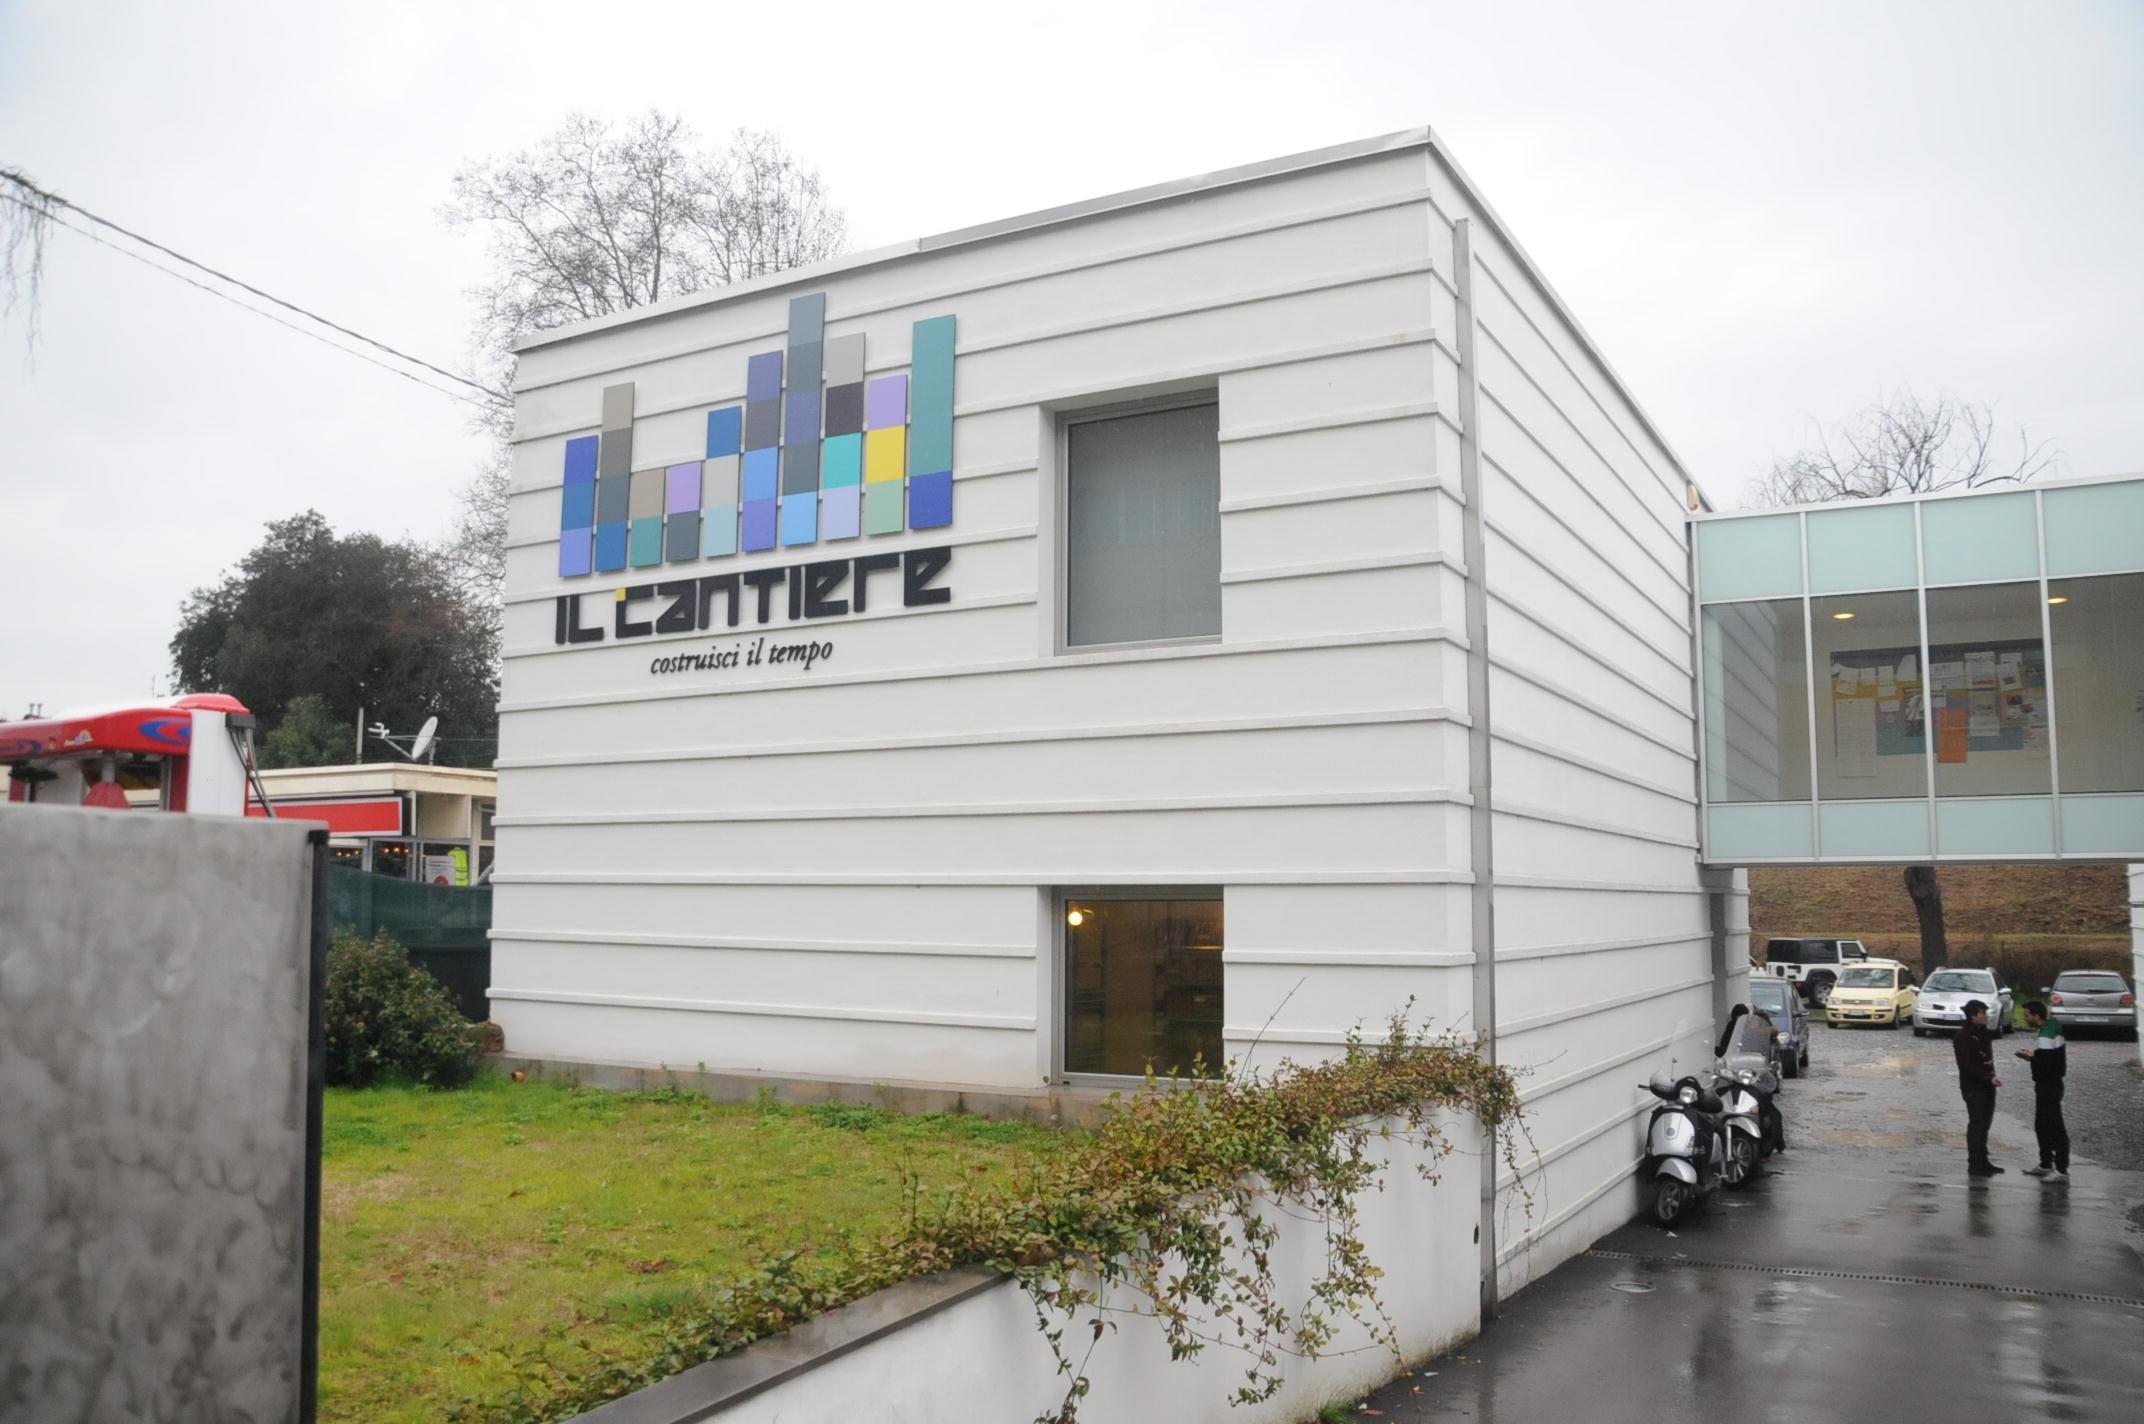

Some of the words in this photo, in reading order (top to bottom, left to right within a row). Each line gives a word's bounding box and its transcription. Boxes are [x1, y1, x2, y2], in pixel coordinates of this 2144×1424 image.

[650, 645, 740, 675] costruisci
[746, 636, 765, 666] il
[768, 640, 833, 671] tempo
